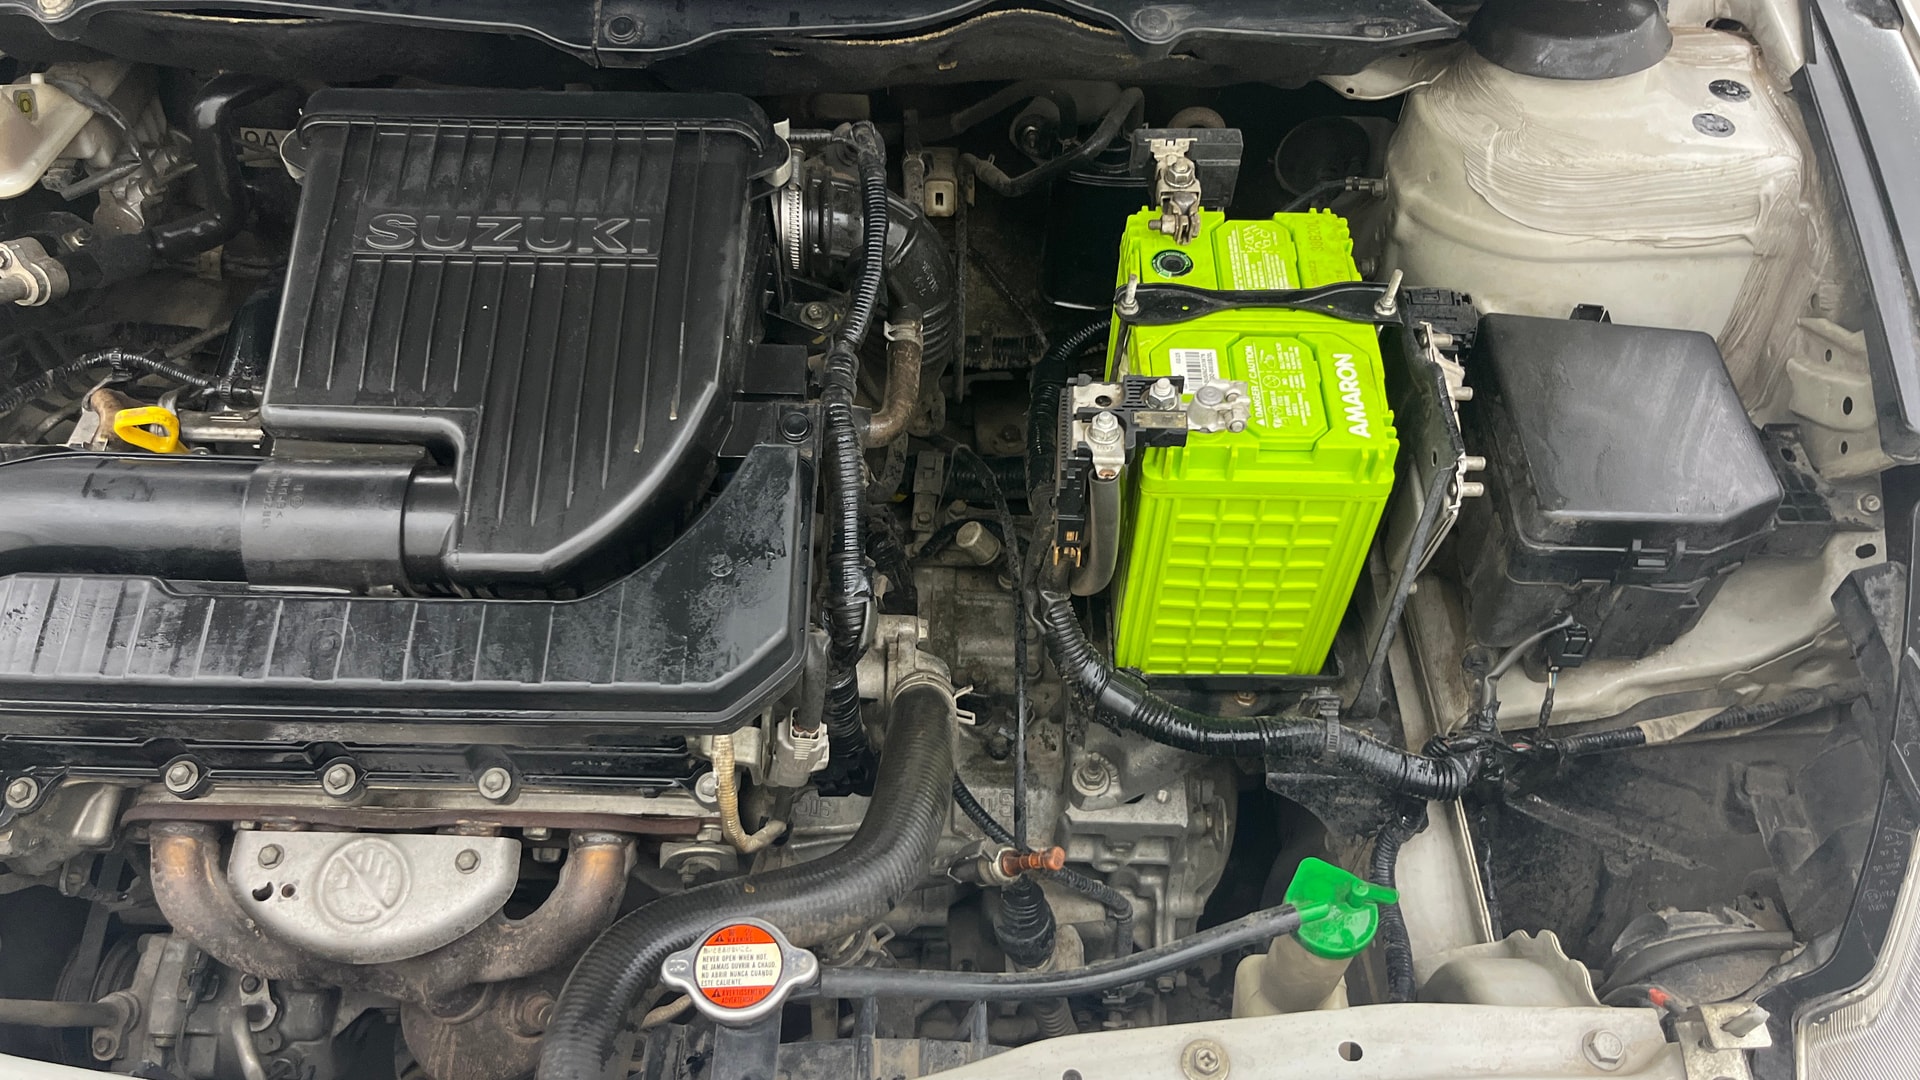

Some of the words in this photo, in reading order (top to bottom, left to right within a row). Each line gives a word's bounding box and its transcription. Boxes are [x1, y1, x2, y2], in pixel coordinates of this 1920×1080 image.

[365, 213, 650, 253] SUZUKI
[1245, 345, 1258, 379] CAUTION
[1251, 386, 1263, 418] DANGER
[1332, 353, 1371, 438] AMARON
